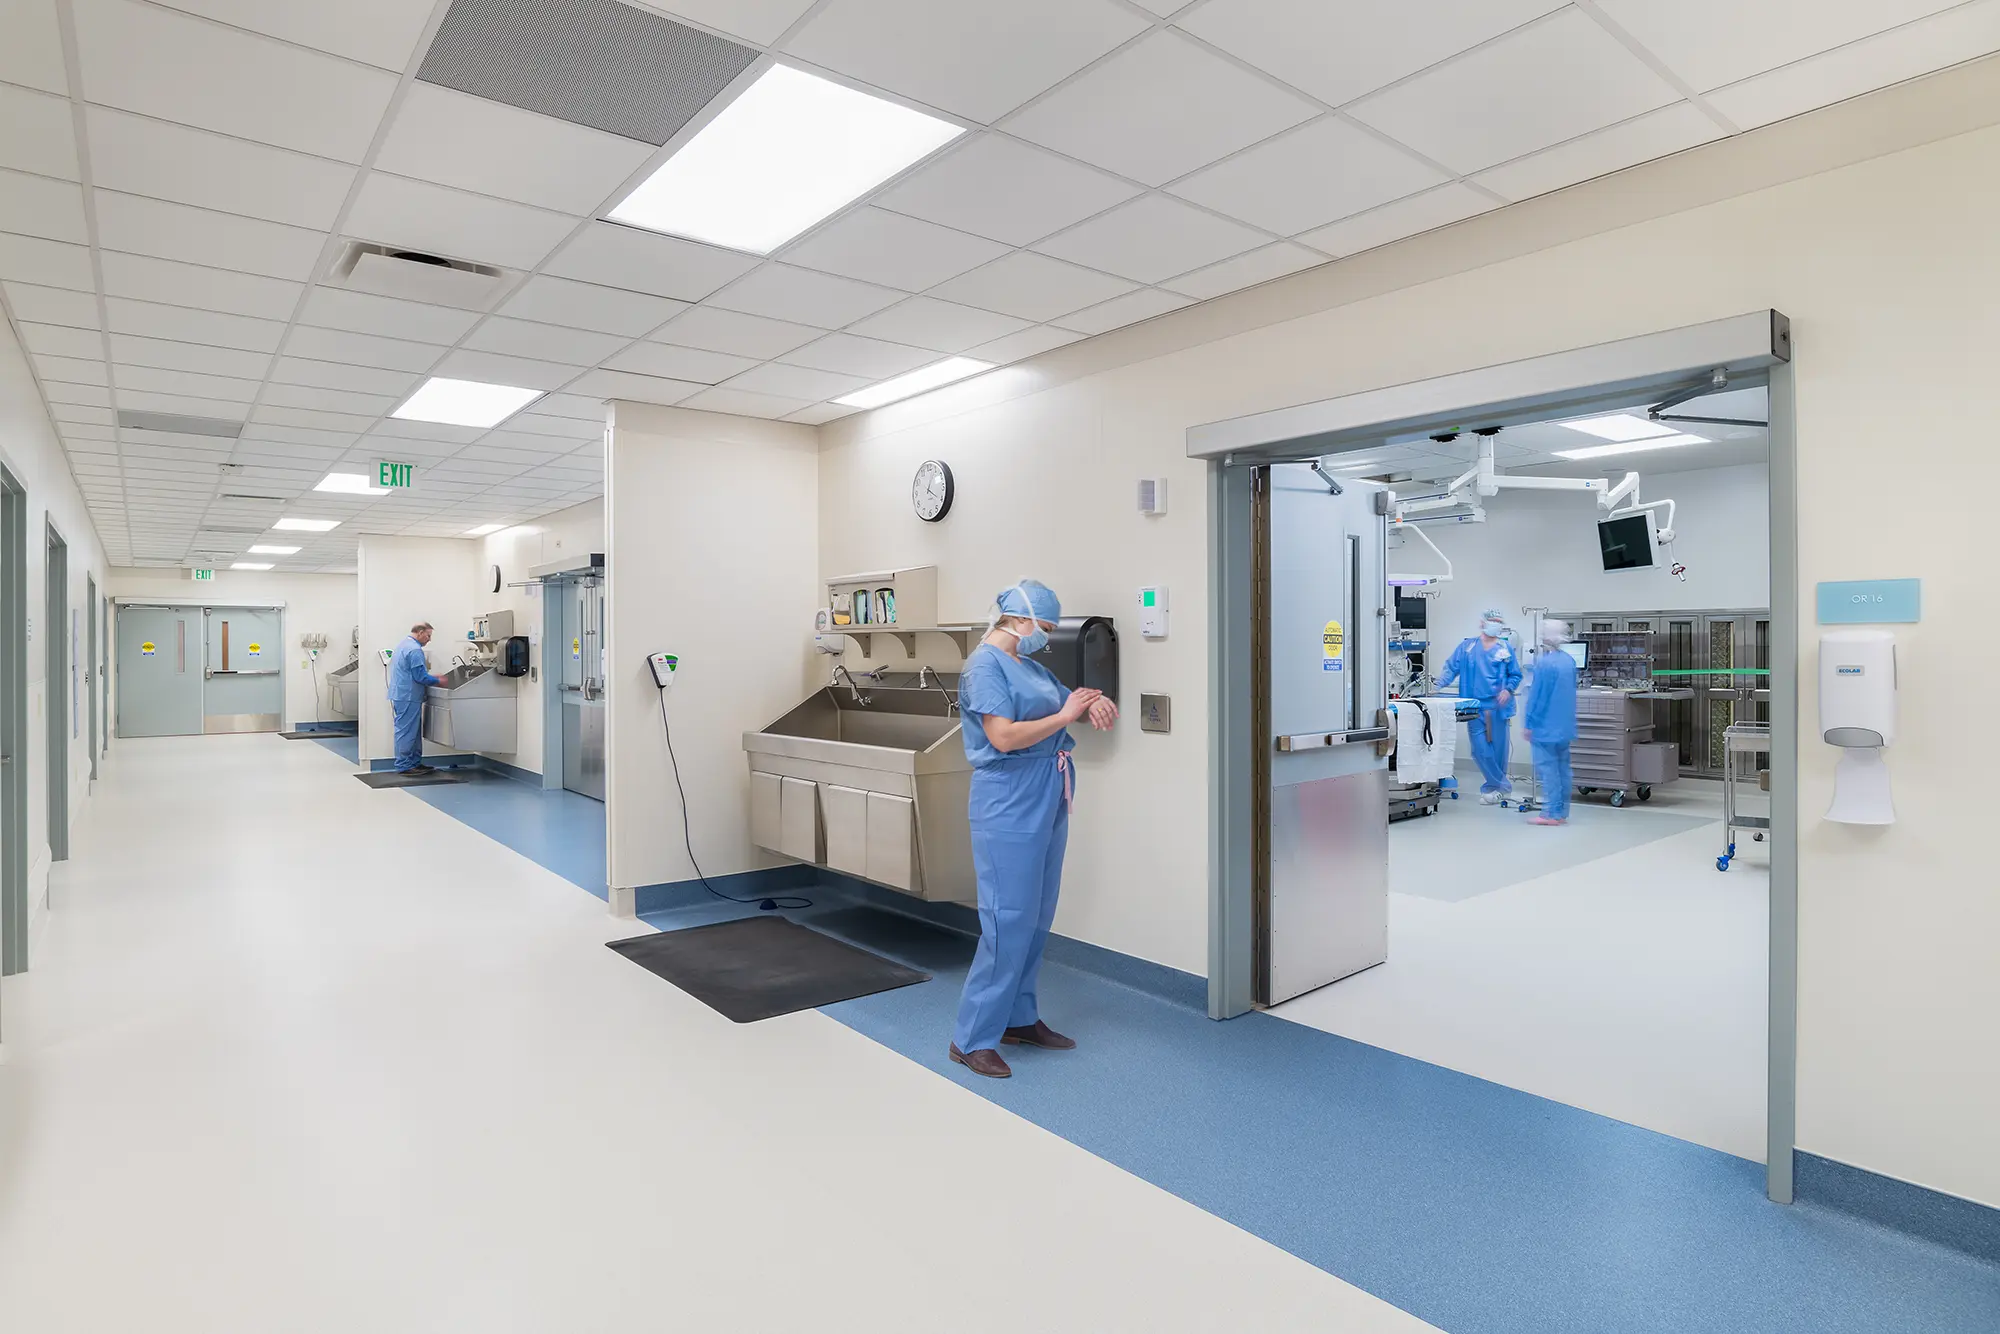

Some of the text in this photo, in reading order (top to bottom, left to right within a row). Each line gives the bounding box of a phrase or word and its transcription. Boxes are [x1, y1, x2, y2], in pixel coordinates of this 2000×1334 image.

[926, 463, 933, 472] 12
[380, 462, 413, 488] EXIT
[196, 569, 211, 580] EXIT
[1851, 594, 1883, 604] OR 16
[1324, 635, 1342, 643] CAUTION
